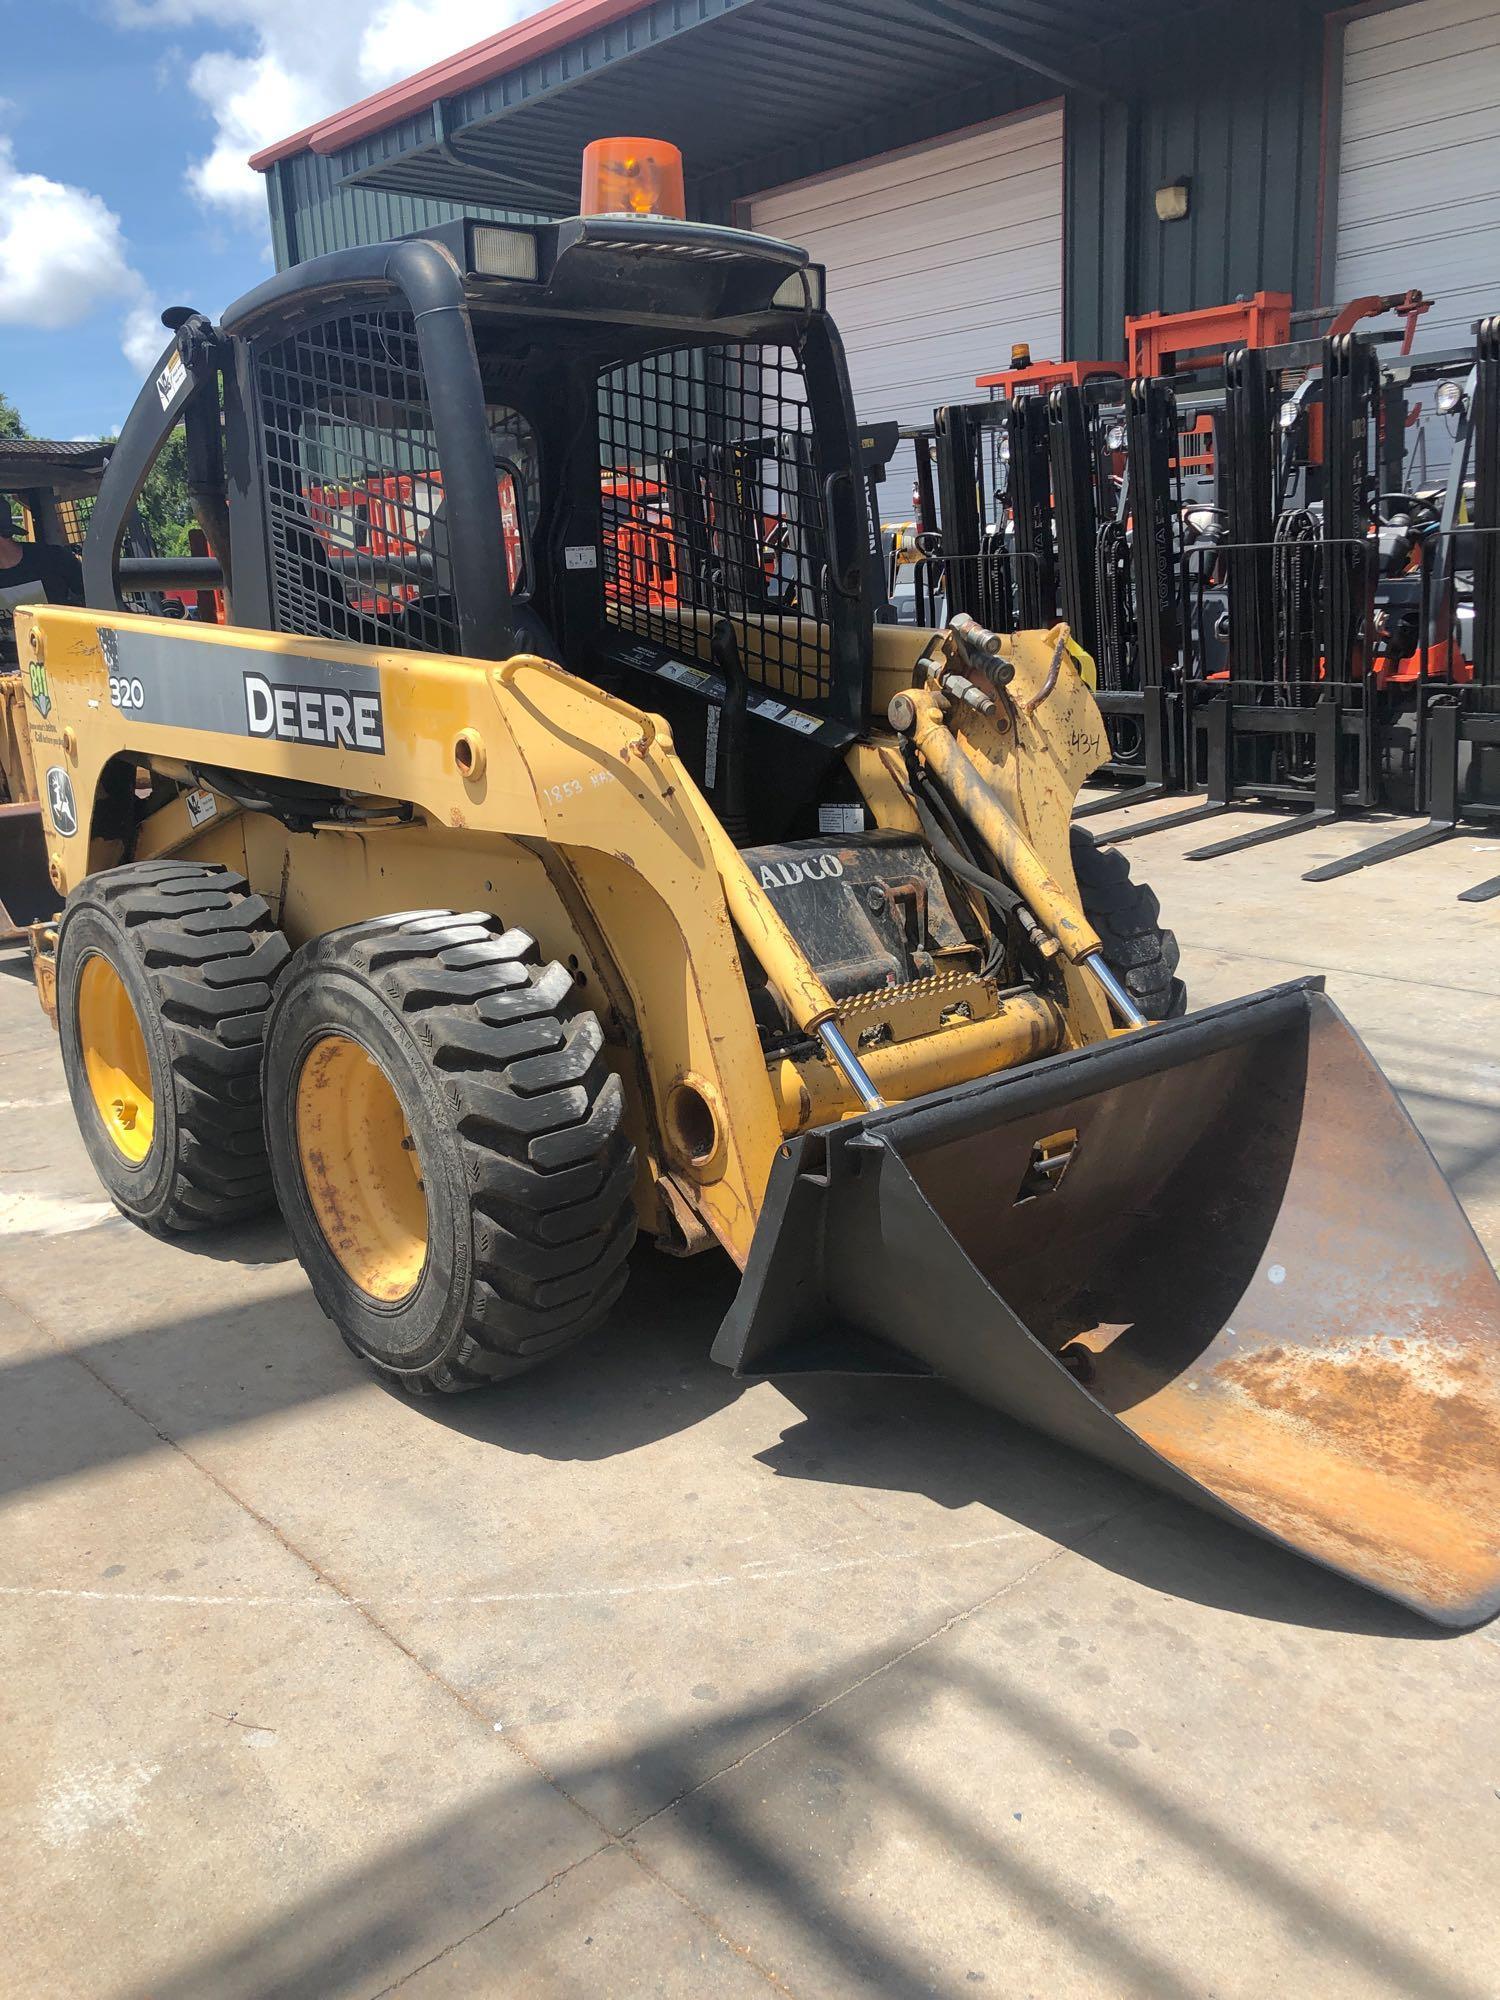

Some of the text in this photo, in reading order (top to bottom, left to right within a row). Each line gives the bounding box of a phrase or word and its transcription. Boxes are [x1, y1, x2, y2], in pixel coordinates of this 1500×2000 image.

[863, 475, 877, 555] NISSAN
[1155, 528, 1169, 611] TOYOTA
[109, 677, 145, 710] 320
[245, 676, 382, 749] DEERE
[1071, 730, 1100, 757] 434
[543, 777, 583, 806] 1853
[760, 854, 843, 889] ADCO
